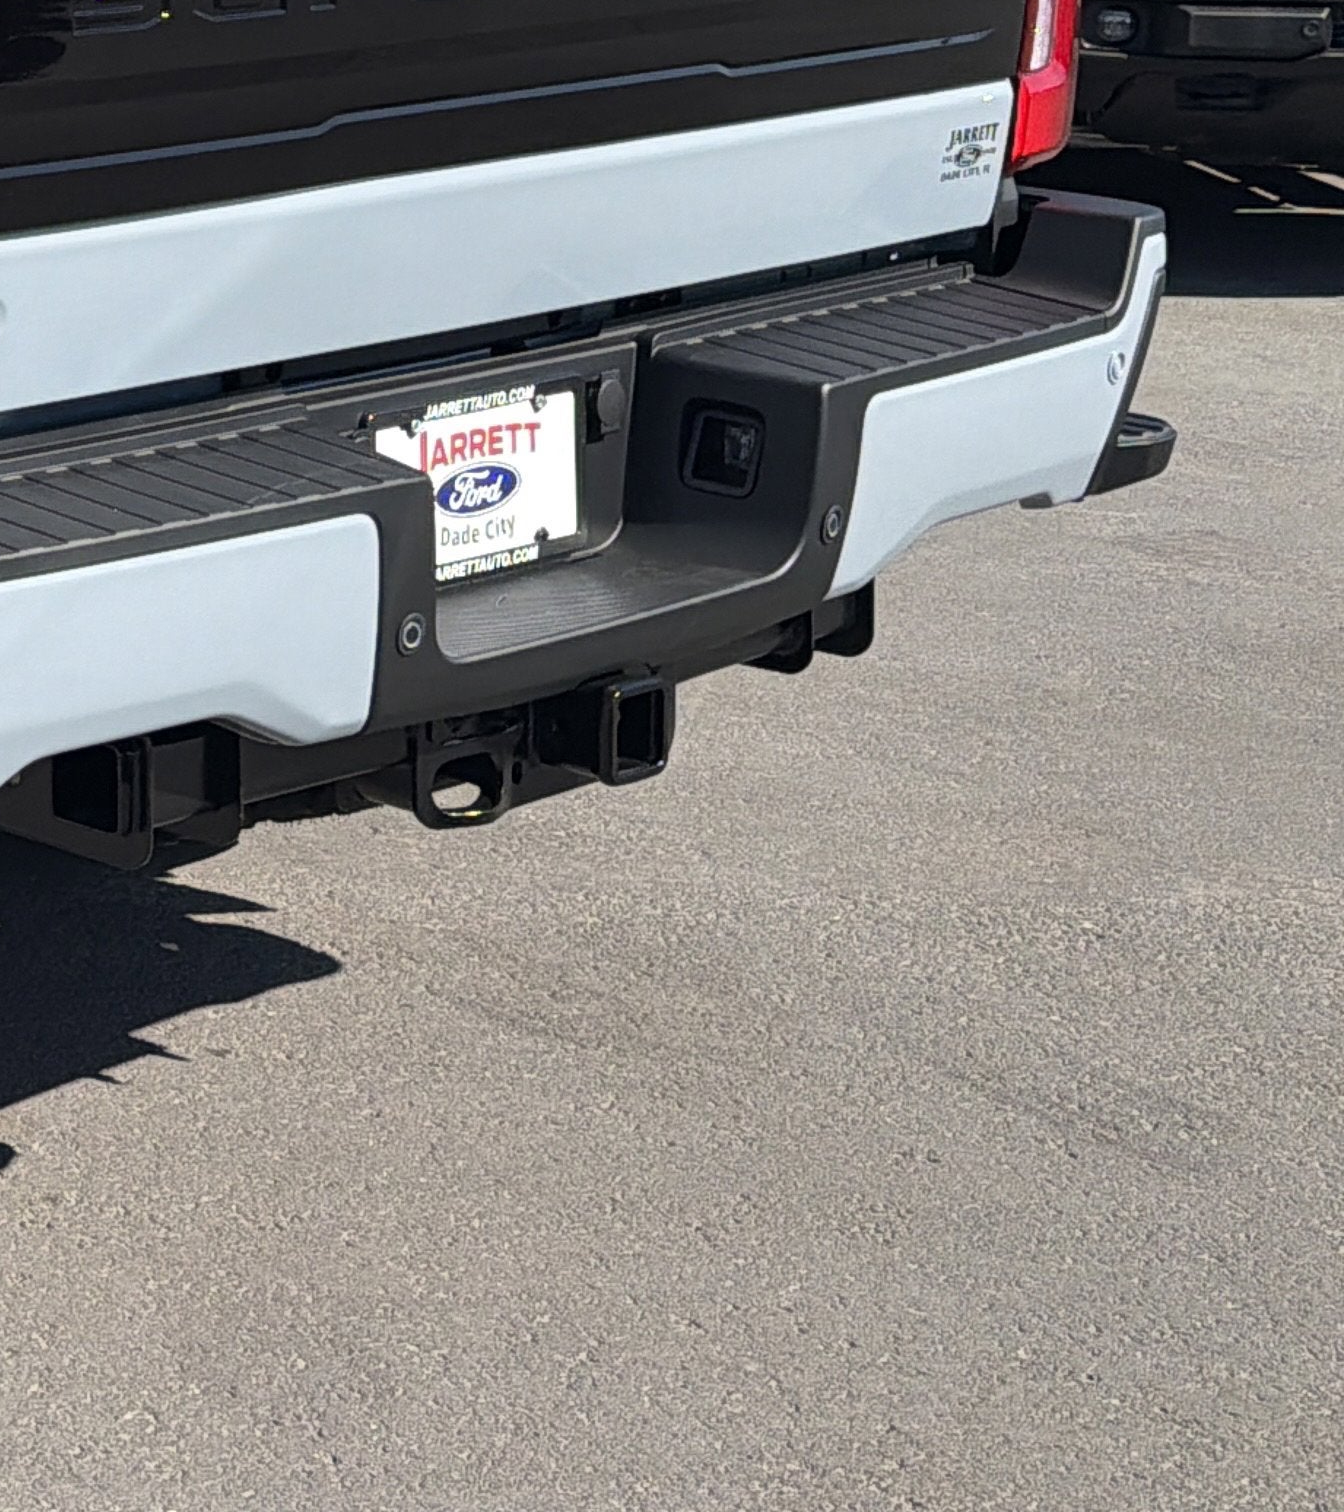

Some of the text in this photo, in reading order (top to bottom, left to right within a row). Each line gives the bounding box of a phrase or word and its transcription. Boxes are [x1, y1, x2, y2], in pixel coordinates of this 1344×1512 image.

[945, 122, 1000, 152] JARRETT
[424, 385, 537, 420] JARRETTAUTO.COM
[419, 422, 542, 474] JARRETT
[448, 469, 505, 511] Ford
[441, 515, 516, 547] Dade City
[435, 544, 540, 582] ARRETTAUTO.COM
